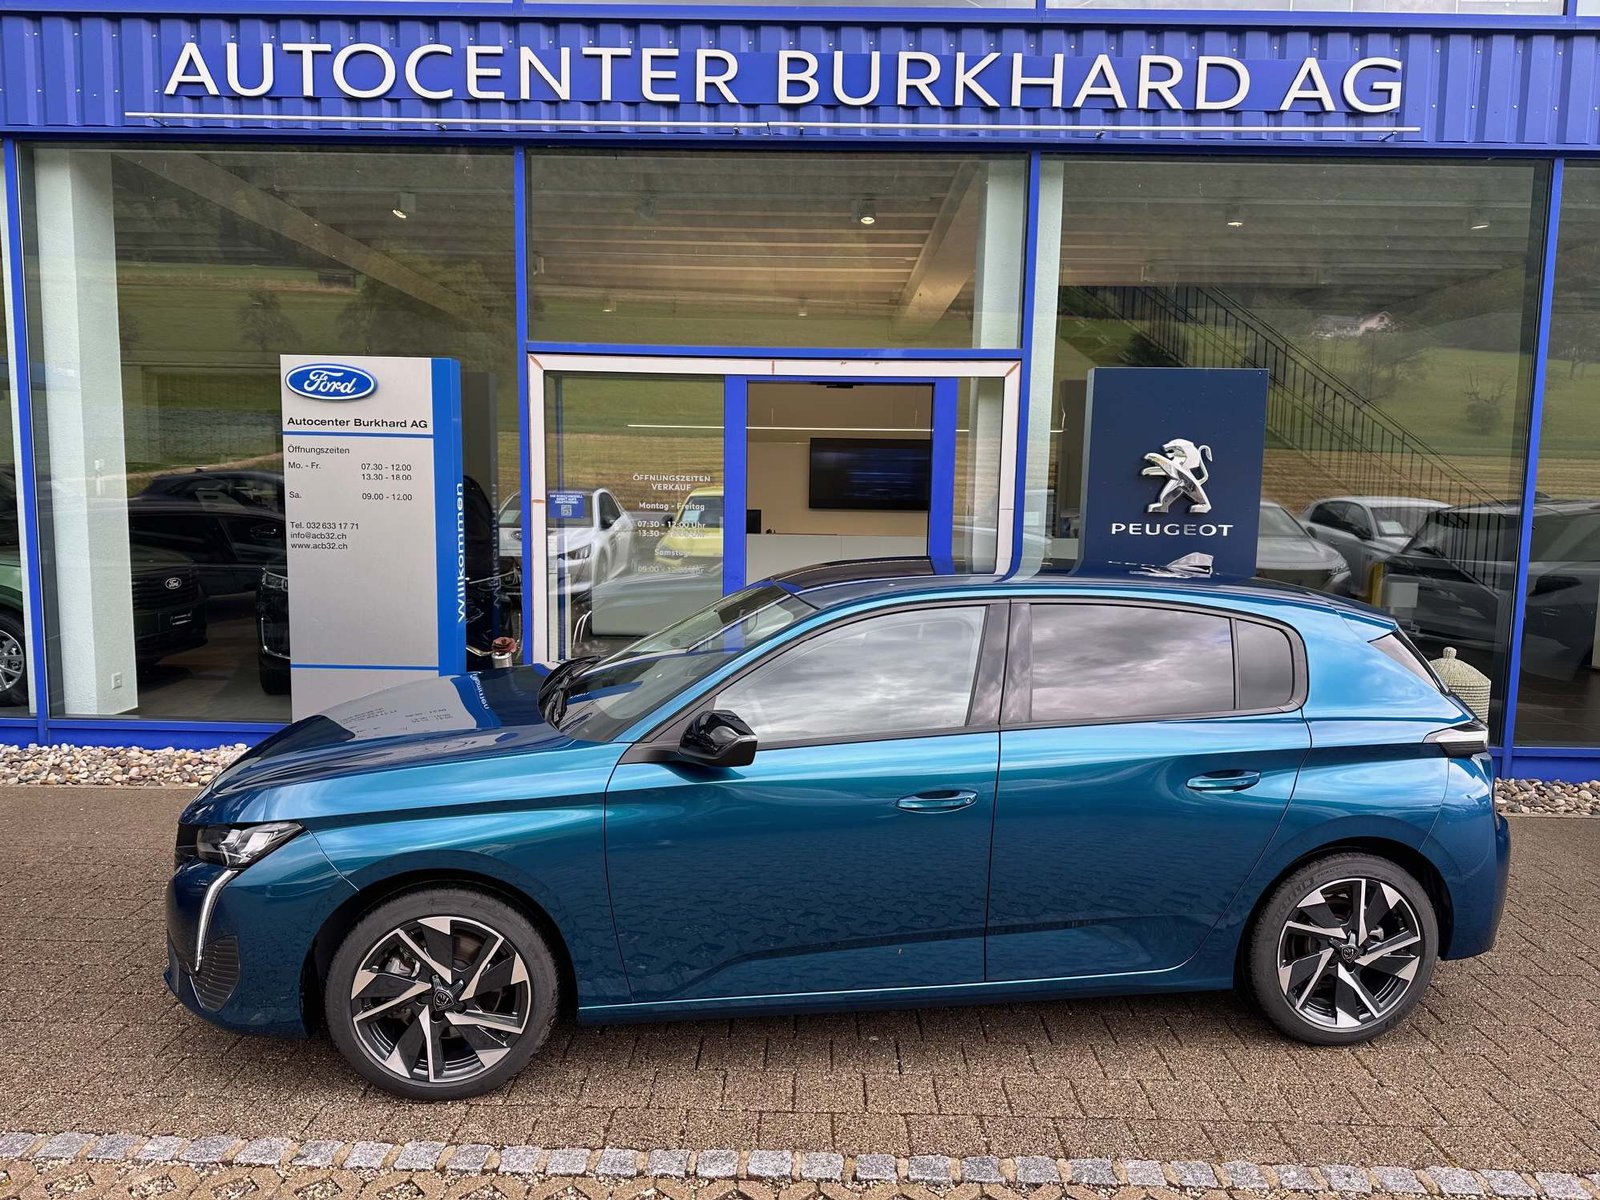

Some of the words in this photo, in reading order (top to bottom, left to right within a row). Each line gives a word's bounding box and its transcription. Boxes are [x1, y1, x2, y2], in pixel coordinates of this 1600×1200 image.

[163, 41, 740, 104] AUTOCENTER
[776, 49, 1252, 111] BURKHARD
[1279, 56, 1403, 114] AG
[303, 369, 357, 394] Ford
[287, 416, 351, 427] Autocenter
[353, 418, 407, 428] Burkhard
[410, 419, 428, 429] AG
[287, 445, 350, 455] Öffnungszeiten
[288, 461, 303, 469] Mo.
[361, 463, 383, 471] 07.30
[391, 464, 412, 472] 12.00
[632, 473, 711, 482] ÖFFNUNGSZEITEN
[651, 483, 692, 491] VERKAUF
[289, 491, 302, 499] Sa.
[361, 493, 384, 501] 09.00
[392, 493, 413, 501] 12.00
[639, 502, 669, 511] Montag
[676, 502, 705, 512] Freitag
[290, 522, 305, 530] Tel.
[306, 522, 321, 530] 032
[322, 522, 337, 530] 633
[338, 522, 348, 530] 17
[350, 522, 359, 530] 71
[637, 520, 660, 528] 07:30
[691, 521, 706, 529] Uhr
[638, 529, 660, 537] 13:30
[1111, 523, 1234, 537] PEUGEOT
[290, 532, 347, 540] info@acb32.ch
[456, 483, 465, 623] Willkommen
[654, 549, 689, 558] Samstag
